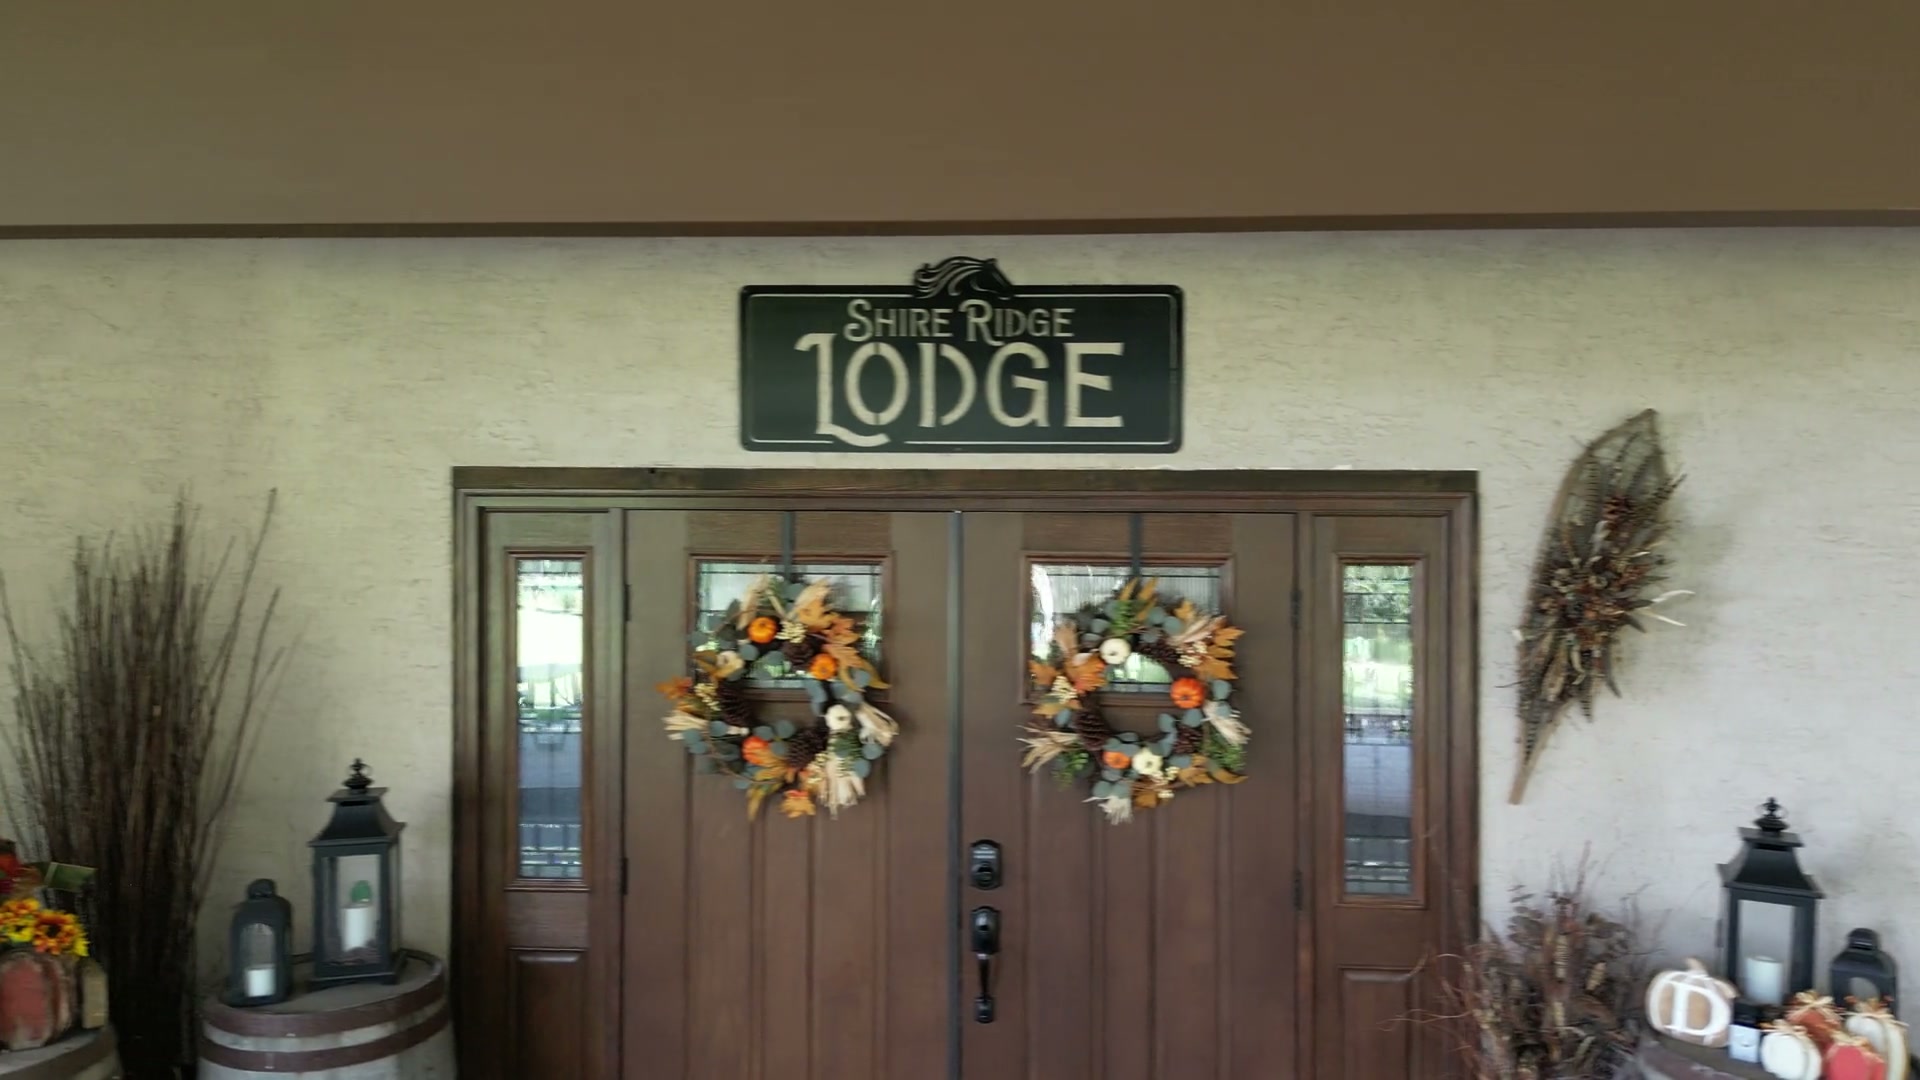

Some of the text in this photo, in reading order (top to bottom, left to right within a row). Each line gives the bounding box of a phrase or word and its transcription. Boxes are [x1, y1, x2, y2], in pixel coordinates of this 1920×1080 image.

[844, 299, 1075, 346] SHIRE RIDGE
[794, 333, 1125, 447] LODGE
